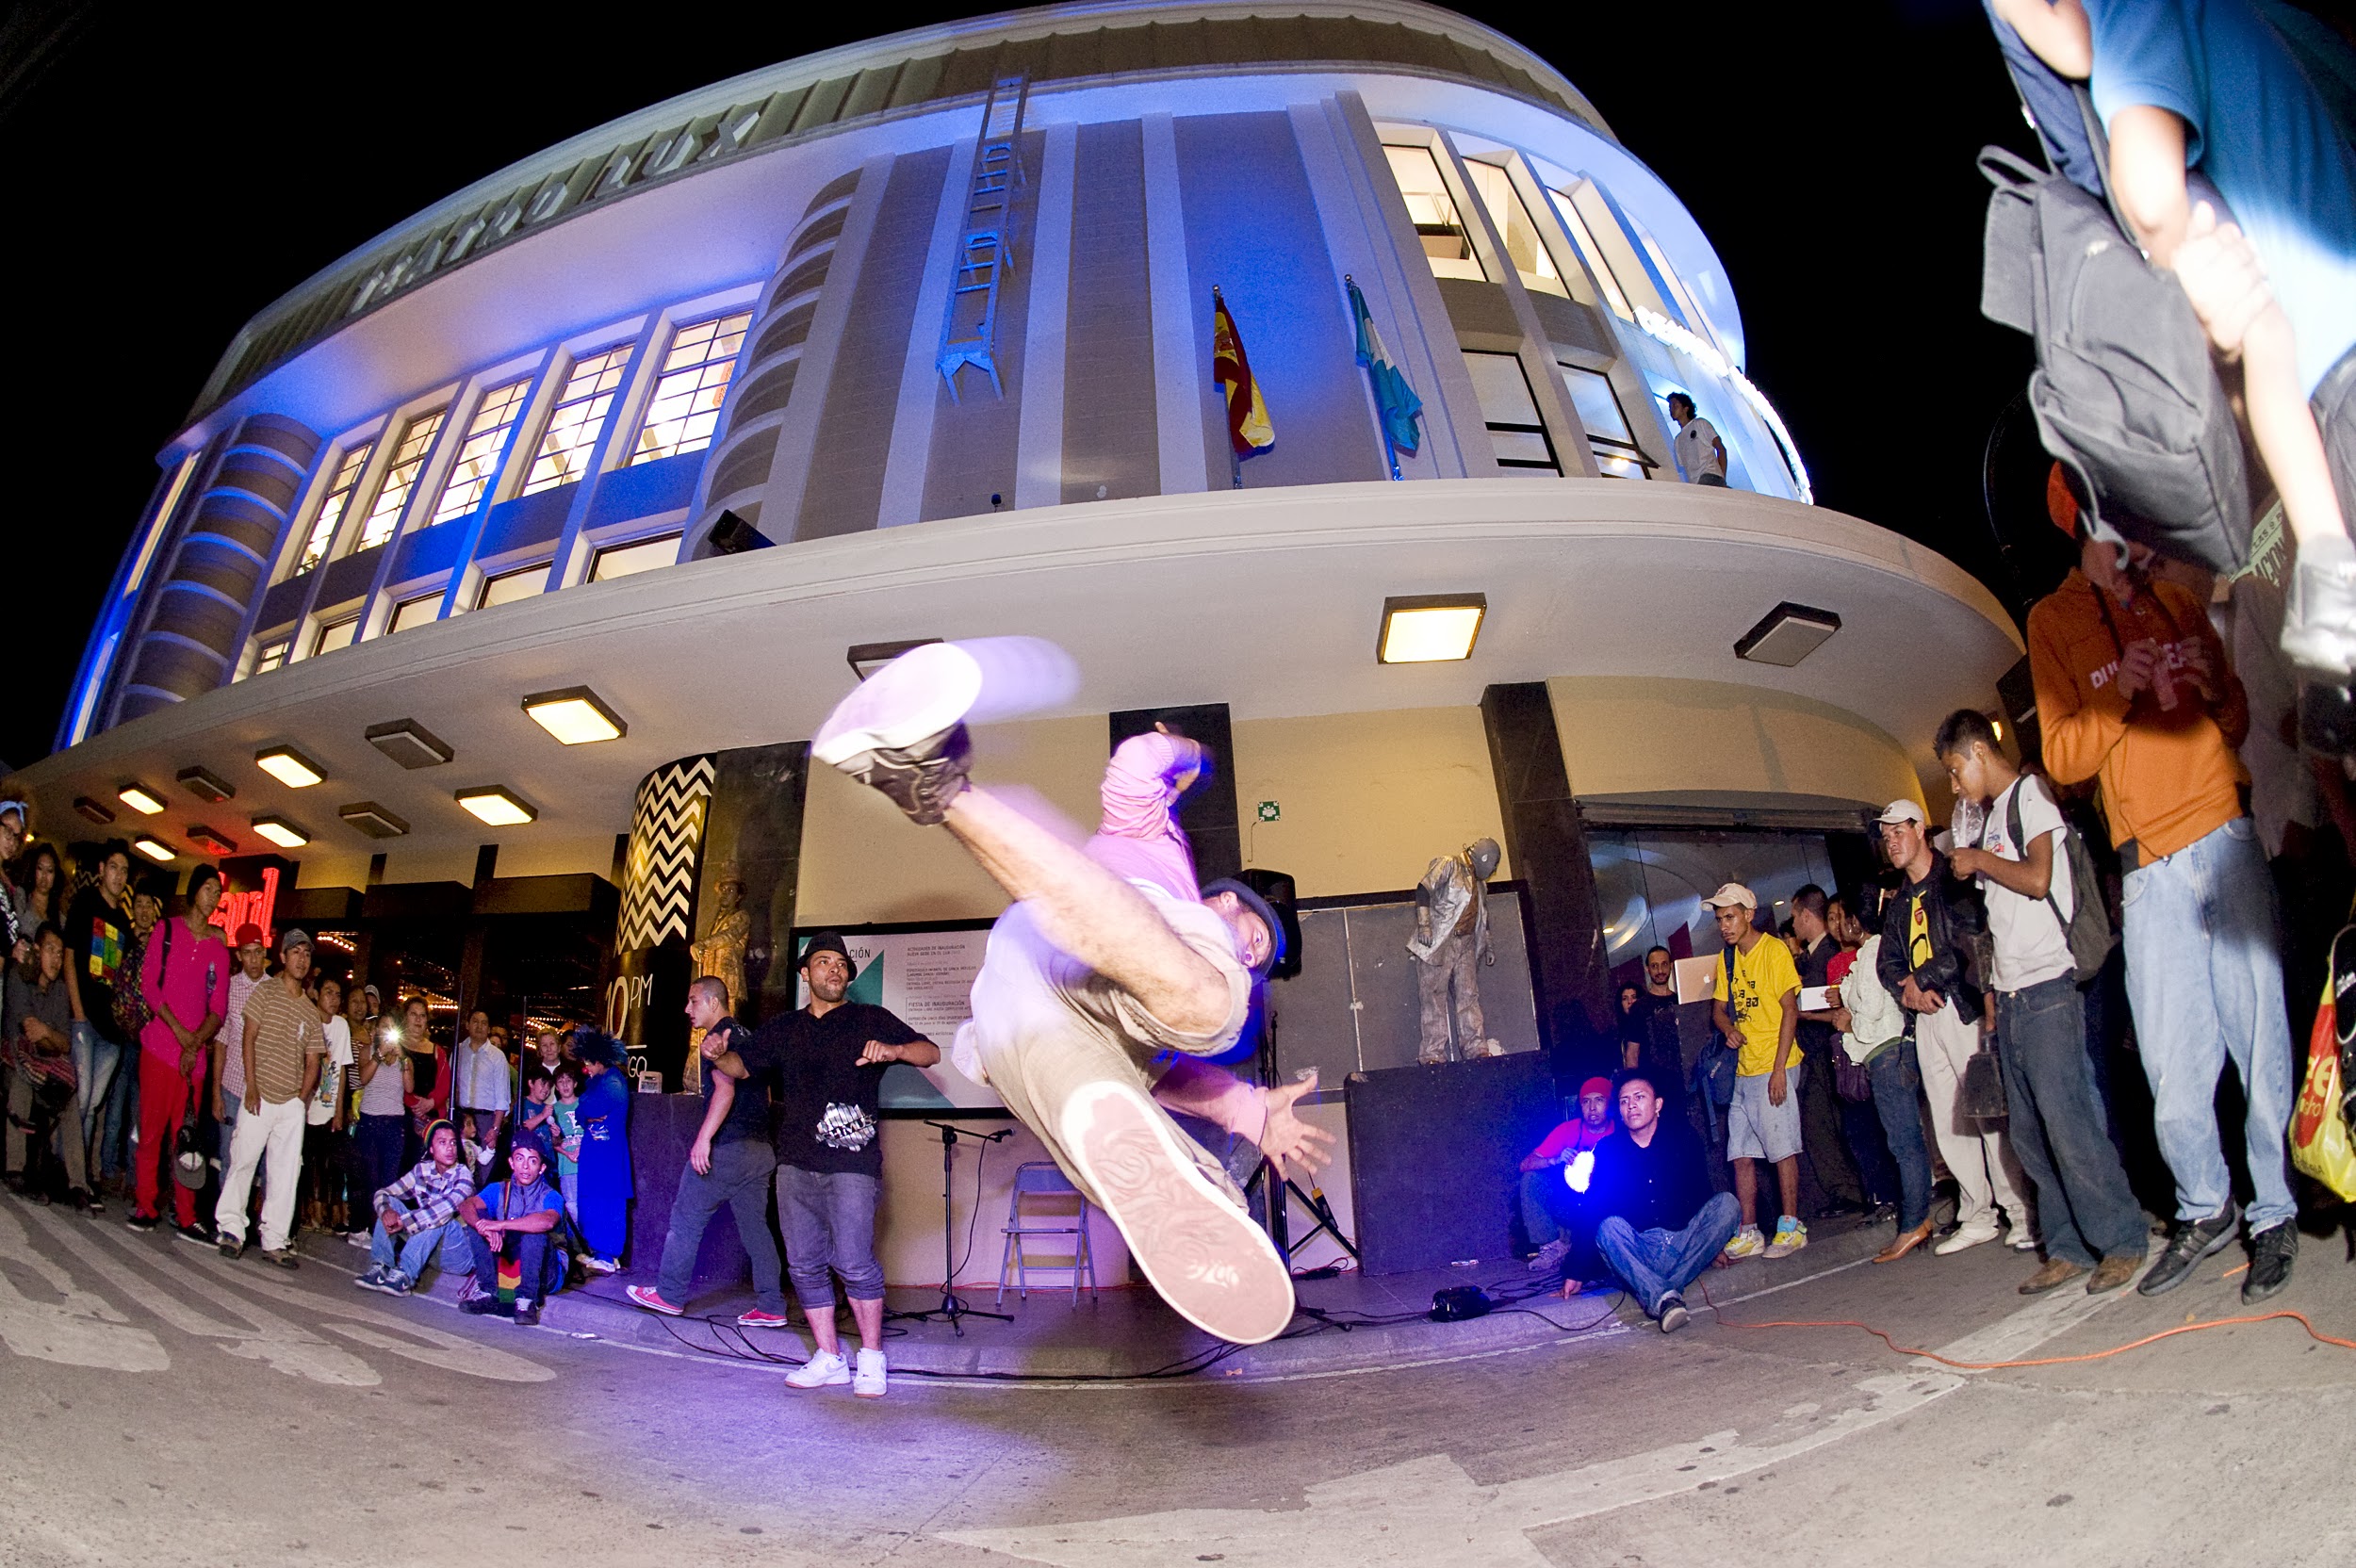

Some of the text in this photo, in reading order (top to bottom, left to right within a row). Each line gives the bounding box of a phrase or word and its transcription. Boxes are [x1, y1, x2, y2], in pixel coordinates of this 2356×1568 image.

[350, 110, 761, 315] TEATRO LUX
[849, 947, 871, 958] CIÓN
